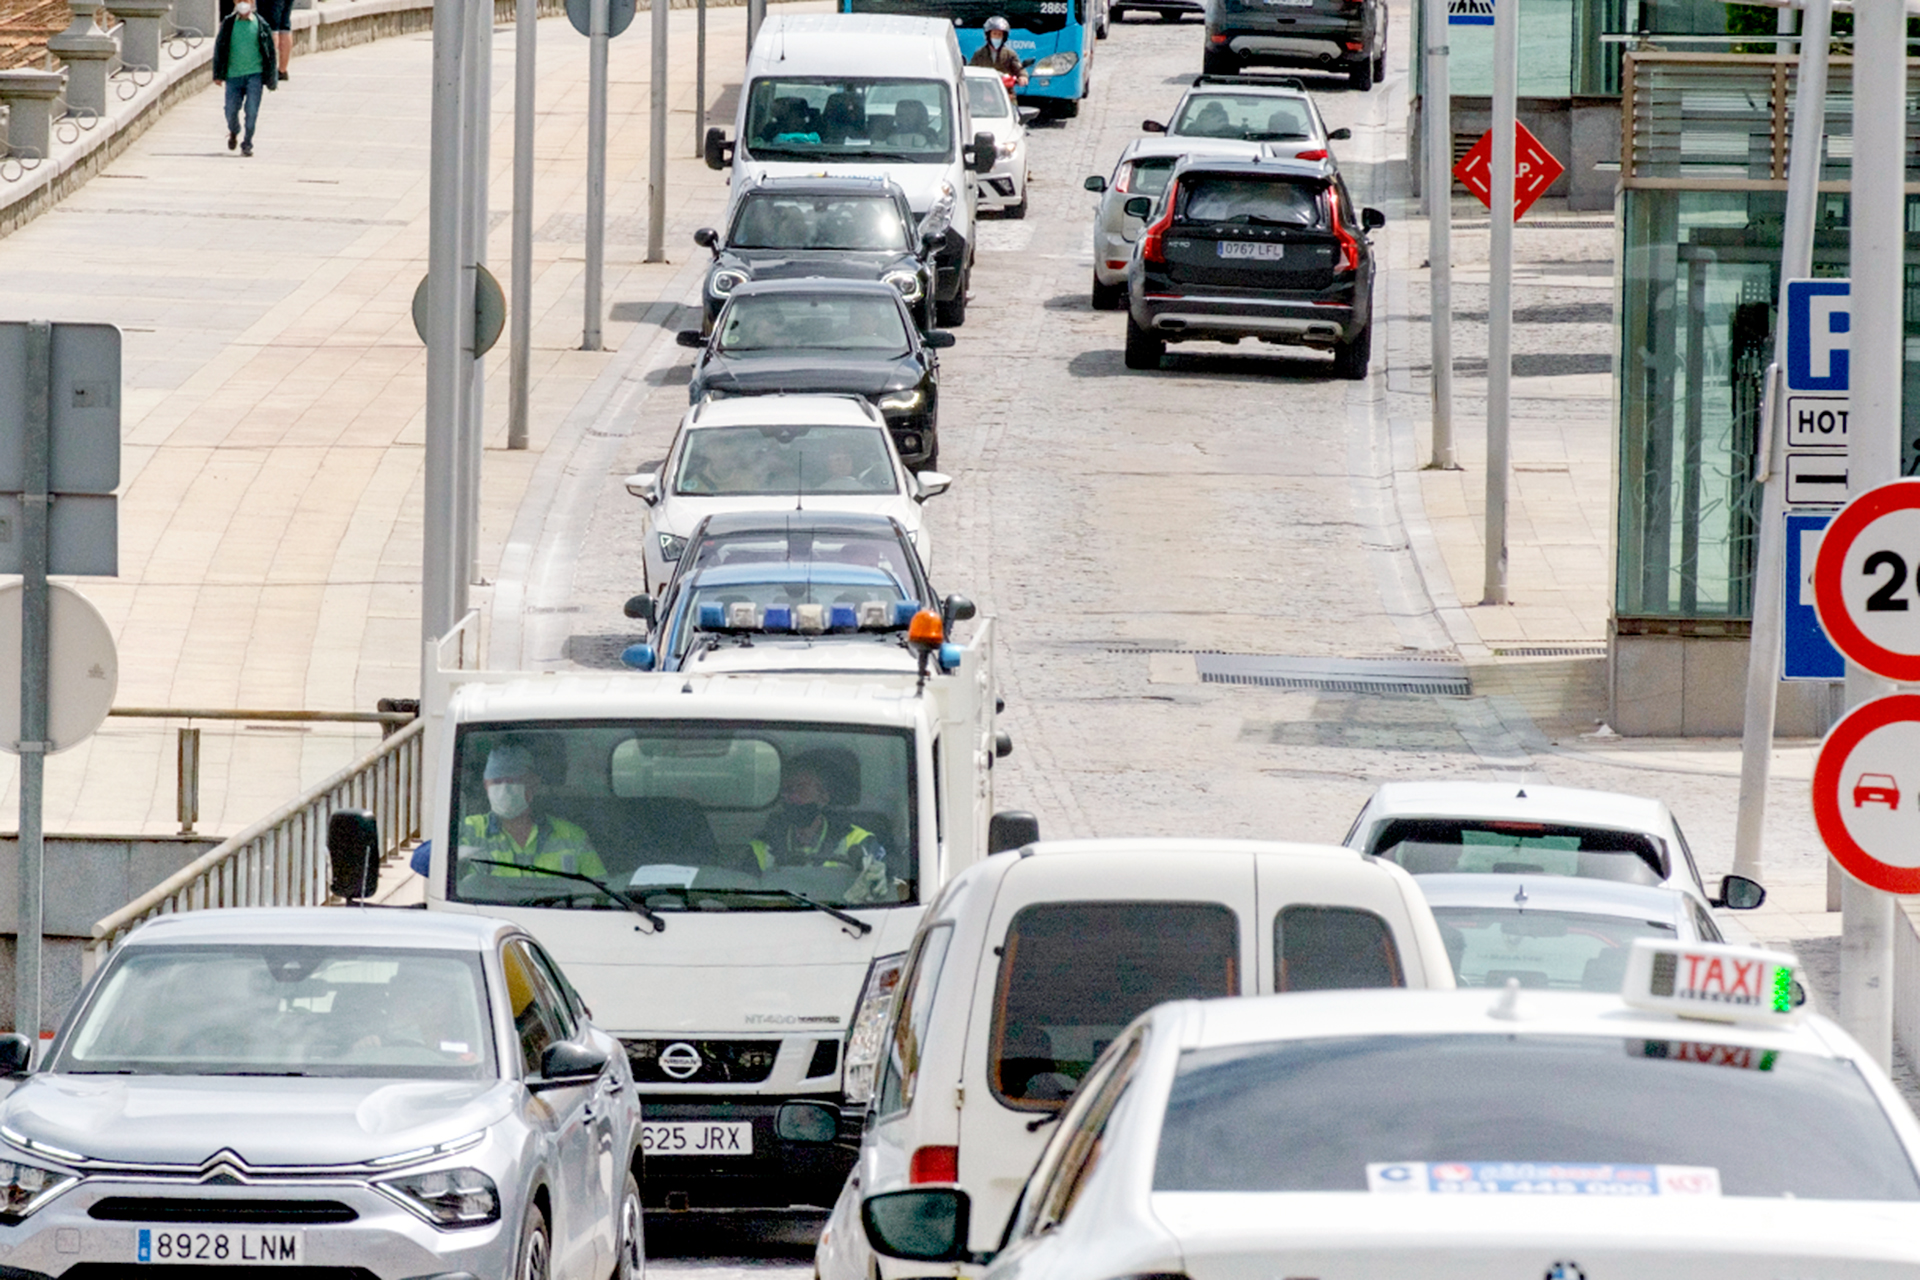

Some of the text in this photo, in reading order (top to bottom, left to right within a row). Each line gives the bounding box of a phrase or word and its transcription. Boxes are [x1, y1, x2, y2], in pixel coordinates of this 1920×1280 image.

[1040, 2, 1068, 14] 2865
[1225, 243, 1281, 257] 0767 LFL
[1684, 953, 1765, 997] TAXI
[696, 1127, 740, 1150] JRX
[157, 1233, 296, 1261] 8928 LNM
